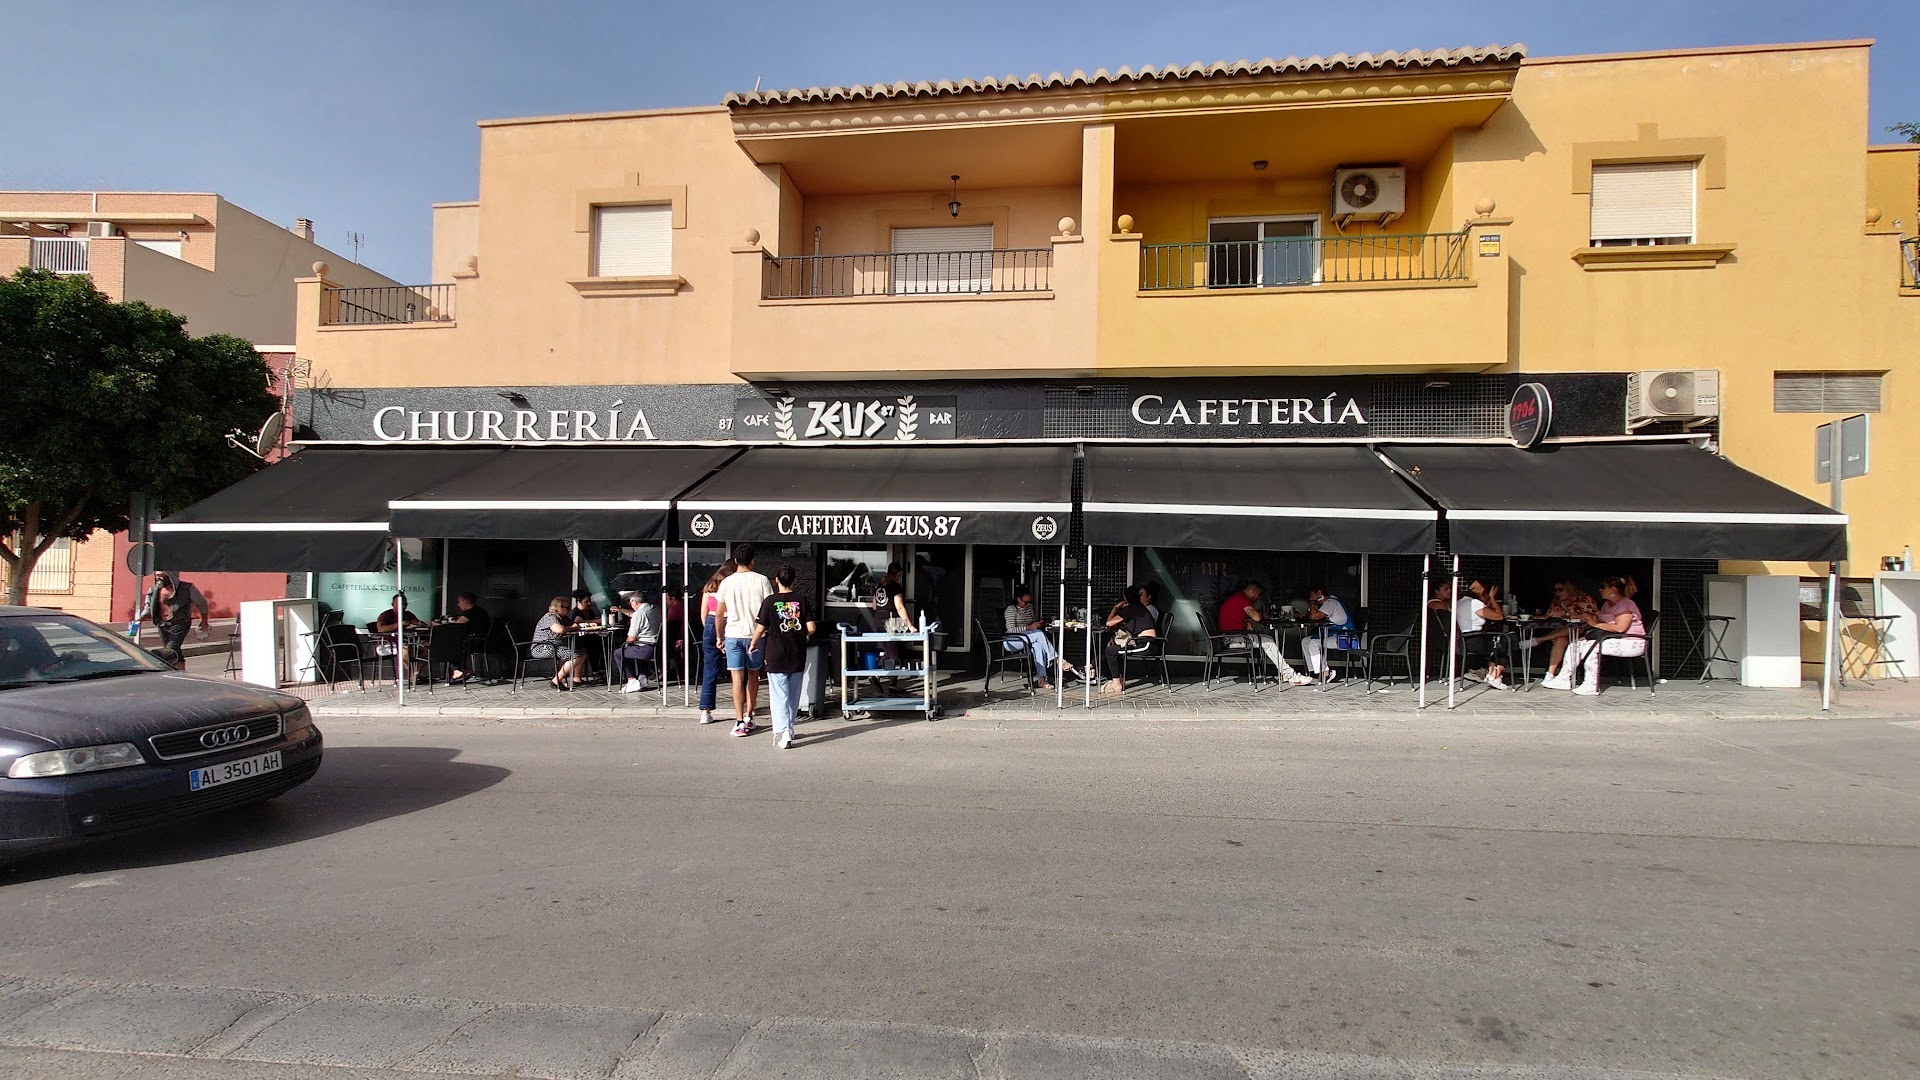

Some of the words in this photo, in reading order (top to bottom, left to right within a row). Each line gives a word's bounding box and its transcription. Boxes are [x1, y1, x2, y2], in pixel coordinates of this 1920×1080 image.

[743, 412, 770, 427] CAFÉ
[804, 400, 886, 438] ZEUS
[880, 405, 895, 417] 87
[929, 412, 952, 425] BAR
[1131, 391, 1369, 425] CAFETERÍA
[1512, 398, 1536, 421] 1906
[372, 399, 659, 441] CHURRERÍA
[718, 418, 734, 431] 87
[695, 521, 710, 530] ZEUS
[777, 514, 873, 536] CAFETERIA
[884, 515, 962, 540] ZEUS,87
[1036, 523, 1053, 532] ZEUS
[202, 769, 220, 786] AL
[224, 759, 258, 779] 3501
[263, 754, 279, 771] AH
